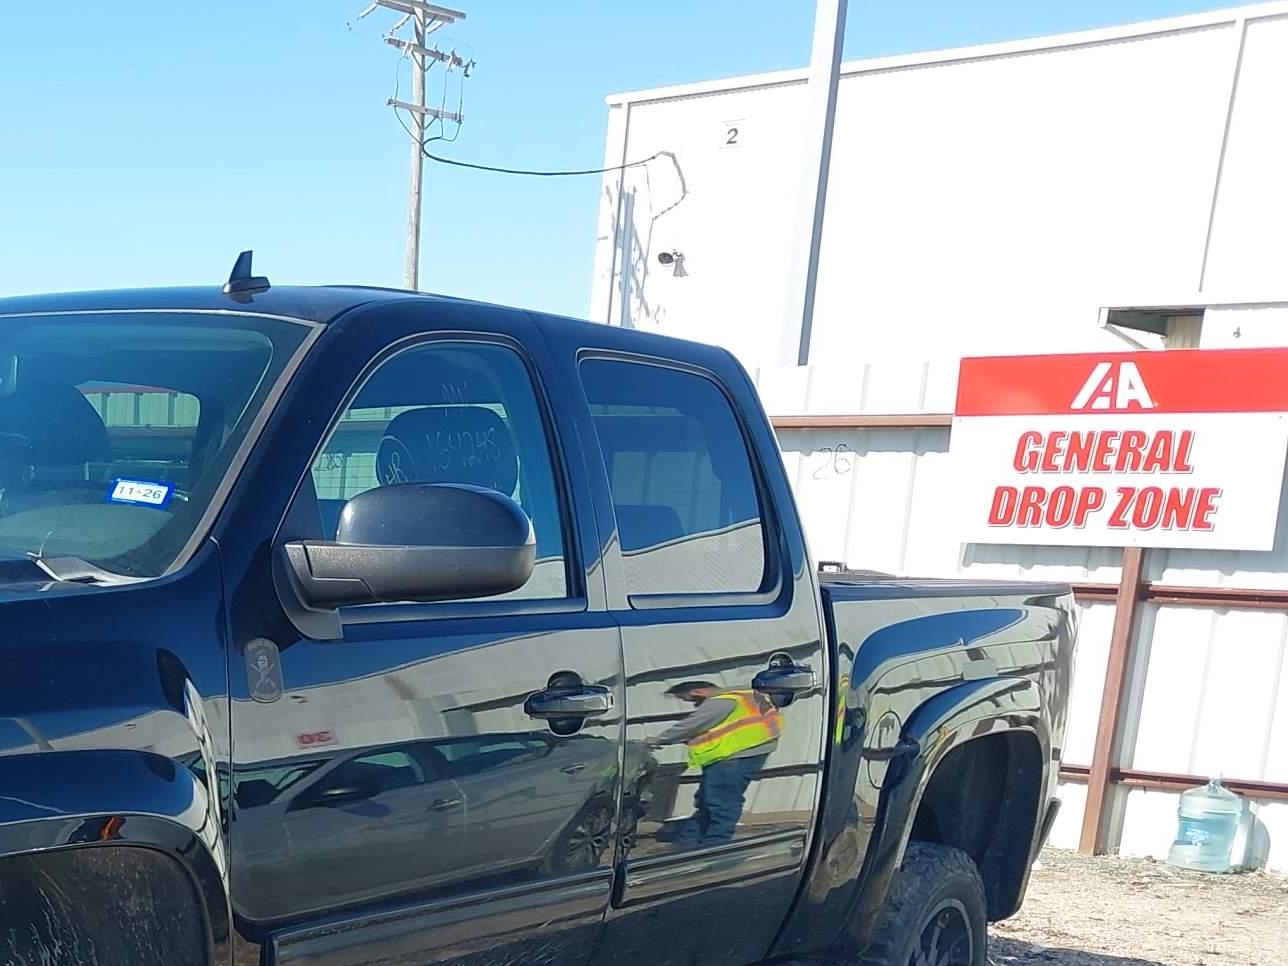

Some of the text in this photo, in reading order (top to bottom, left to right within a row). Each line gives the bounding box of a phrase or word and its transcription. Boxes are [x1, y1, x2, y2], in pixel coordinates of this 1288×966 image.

[726, 127, 739, 145] 2
[1012, 430, 1196, 475] GENERAL
[987, 485, 1222, 533] DROP ZONE
